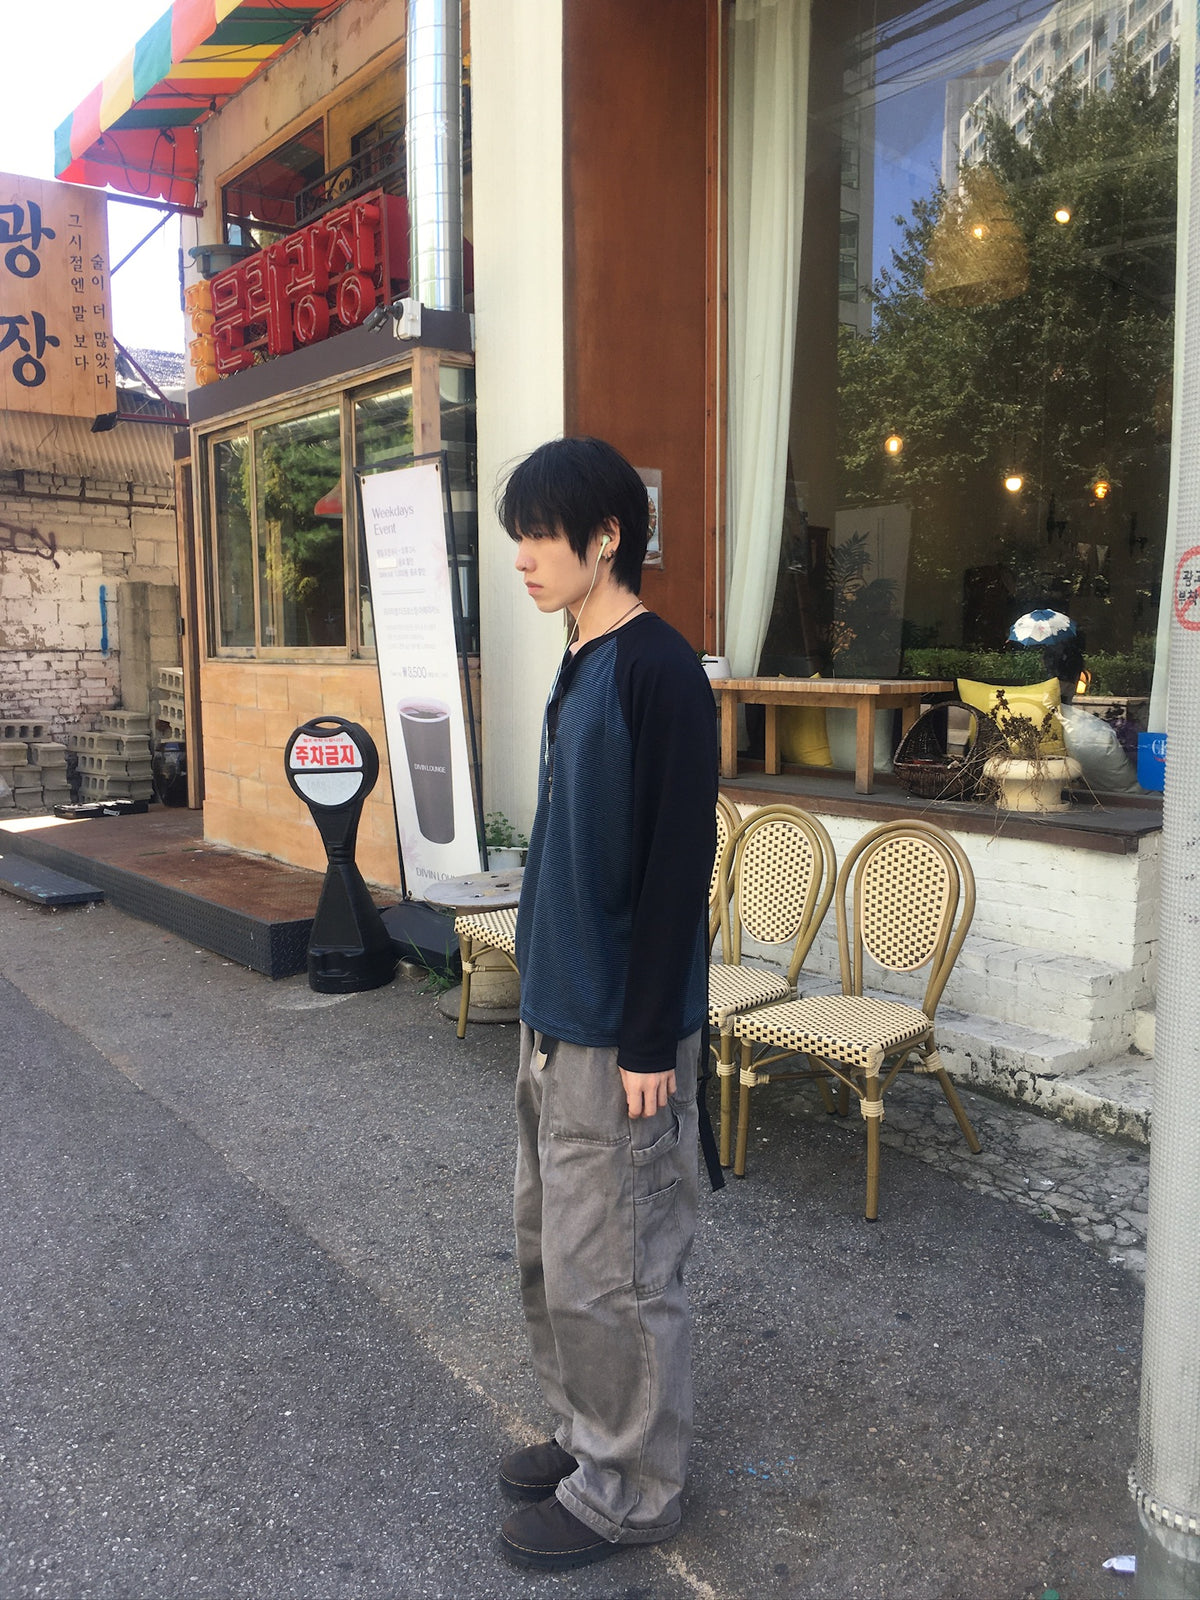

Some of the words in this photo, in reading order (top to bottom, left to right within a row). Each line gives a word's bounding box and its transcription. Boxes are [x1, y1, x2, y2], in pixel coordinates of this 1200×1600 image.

[90, 254, 105, 292] 술이
[0, 200, 61, 388] 광장
[210, 203, 380, 374] 문래광장
[93, 303, 106, 320] 더
[94, 331, 111, 390] 많았다
[372, 505, 415, 519] Weekdays
[373, 523, 397, 536] Event
[295, 744, 355, 767] 주차금지
